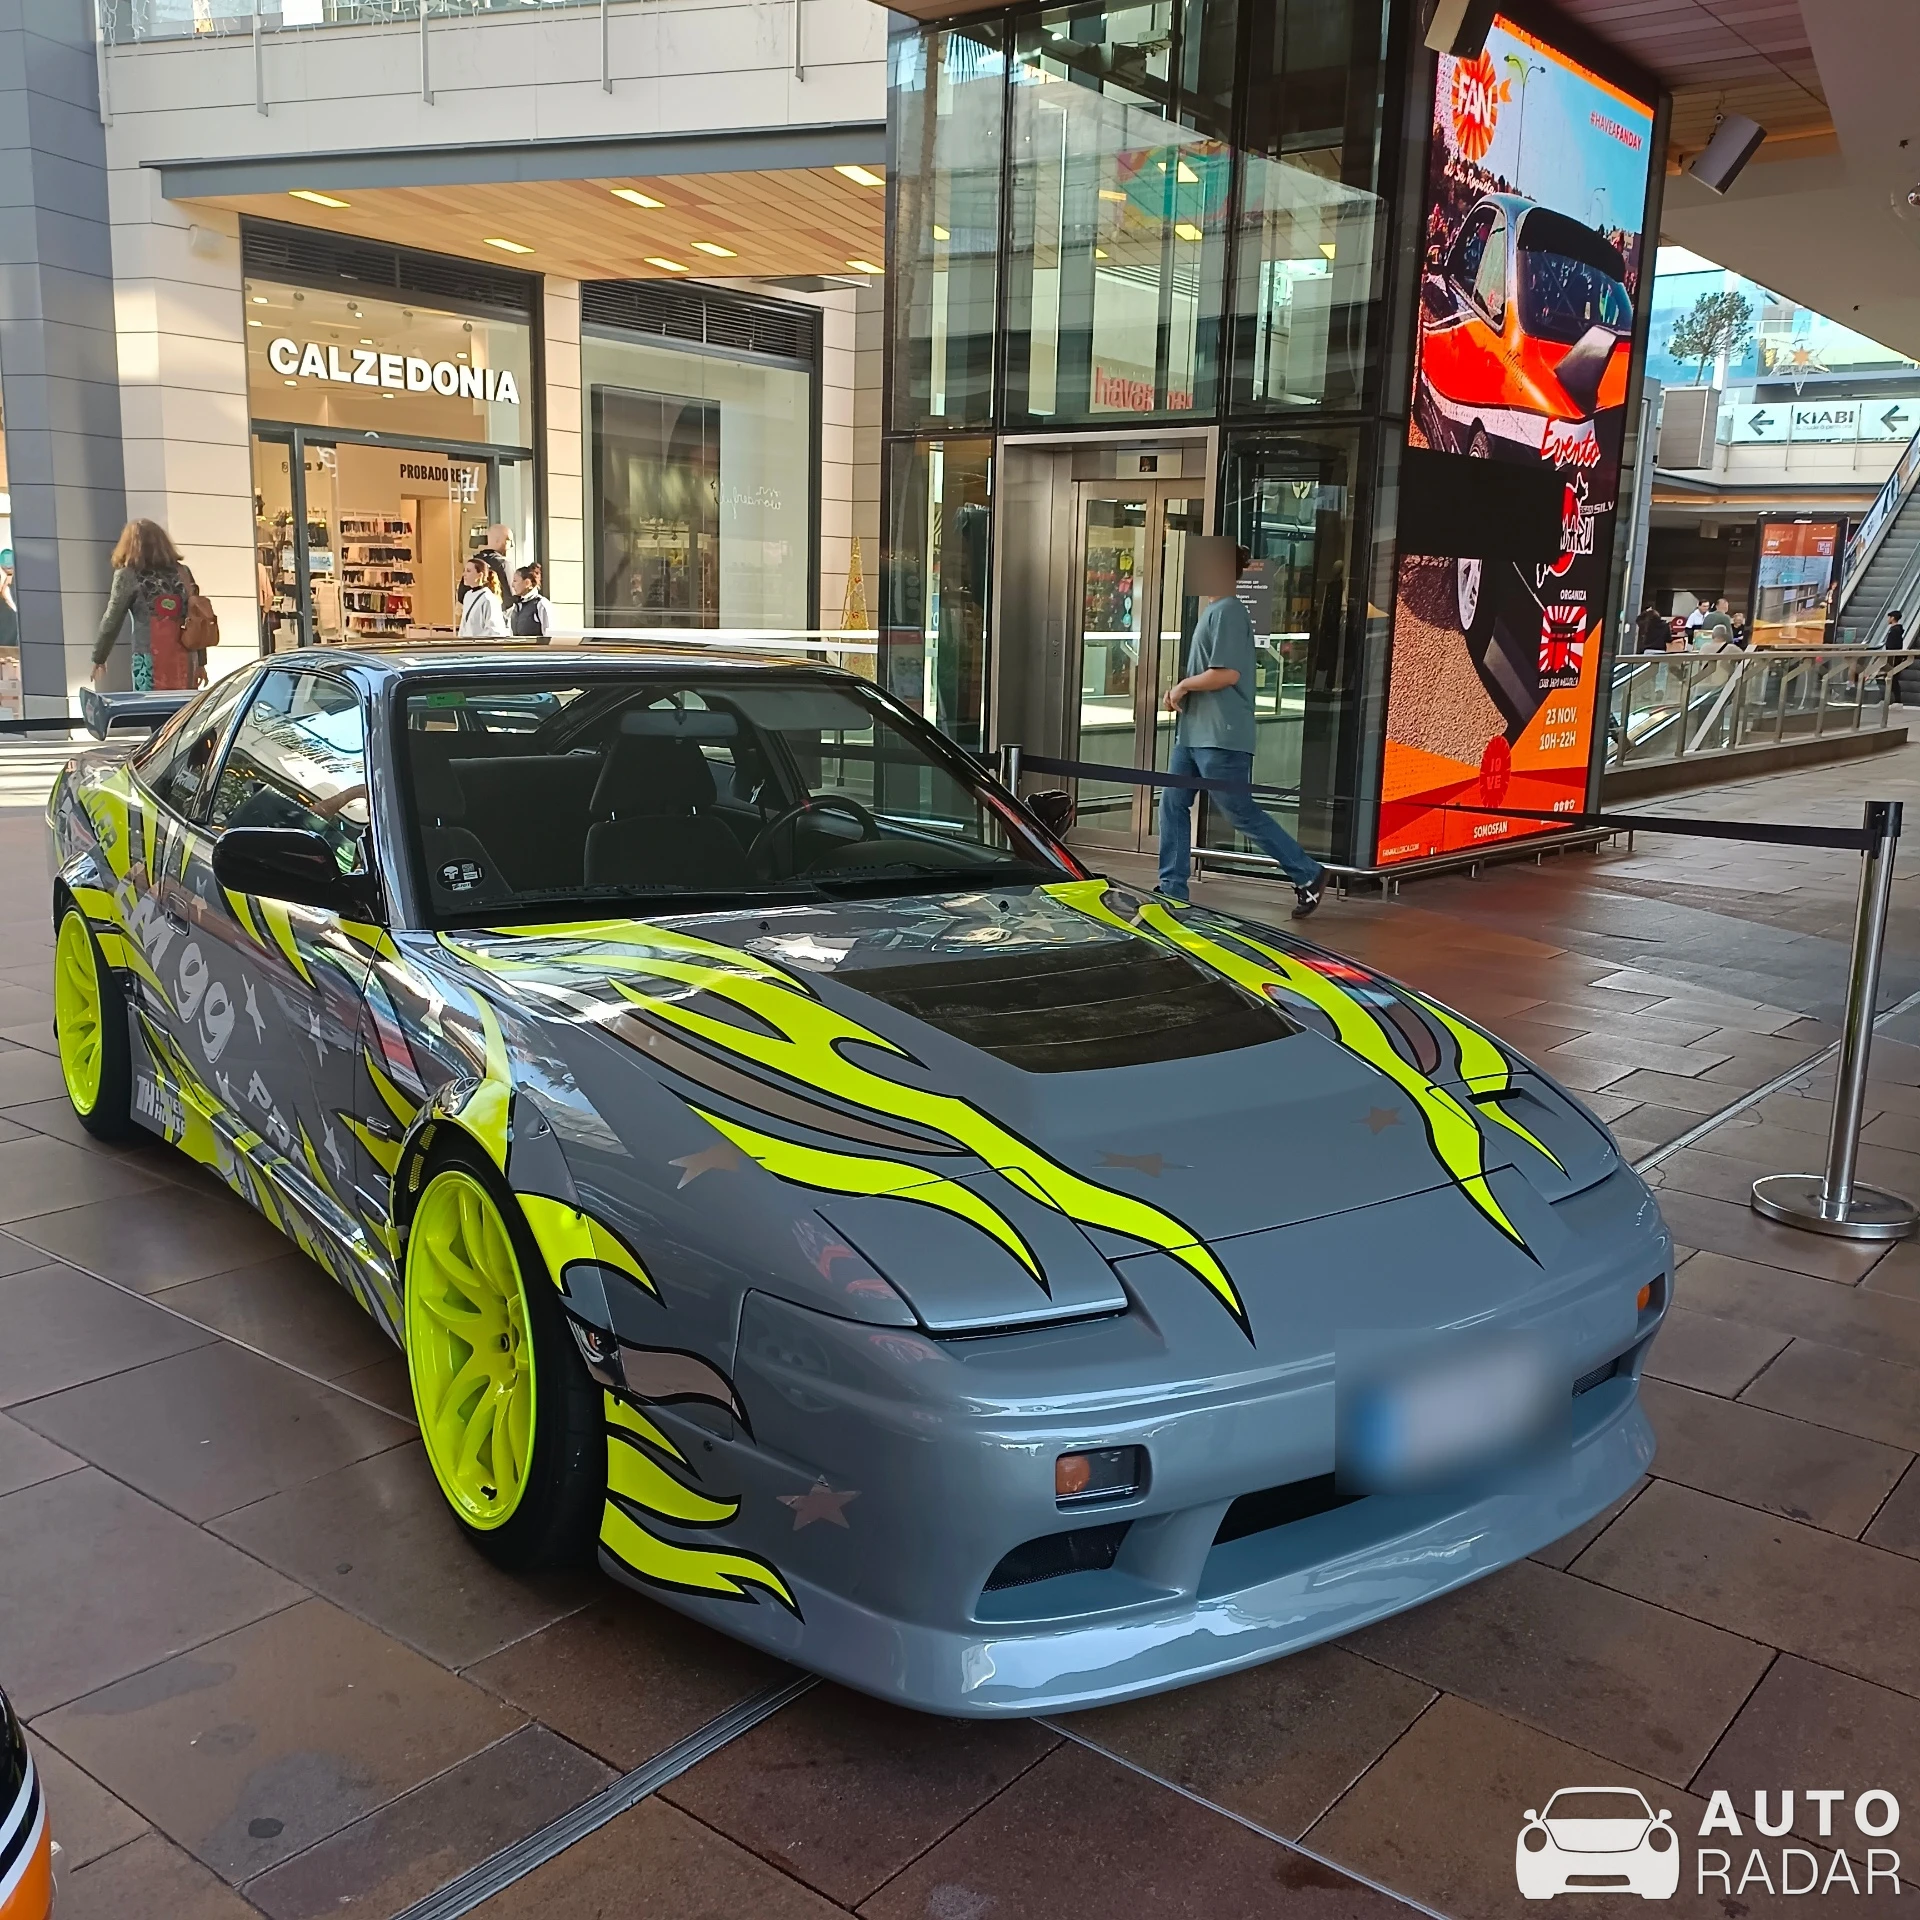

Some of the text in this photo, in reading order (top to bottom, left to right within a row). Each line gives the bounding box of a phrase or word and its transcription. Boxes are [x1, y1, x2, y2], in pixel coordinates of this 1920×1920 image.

[1457, 72, 1493, 128] FAN
[1589, 111, 1643, 151] #HAVEAFANDAY
[267, 337, 521, 404] CALZEDONIA
[1796, 410, 1855, 425] KIABI
[1540, 414, 1602, 470] Evento
[1560, 589, 1587, 601] ORGANIZA
[1545, 709, 1557, 726] 23
[1539, 730, 1577, 751] 10H-22H
[1486, 776, 1501, 791] VE
[1473, 820, 1508, 839] SOMOSFAN
